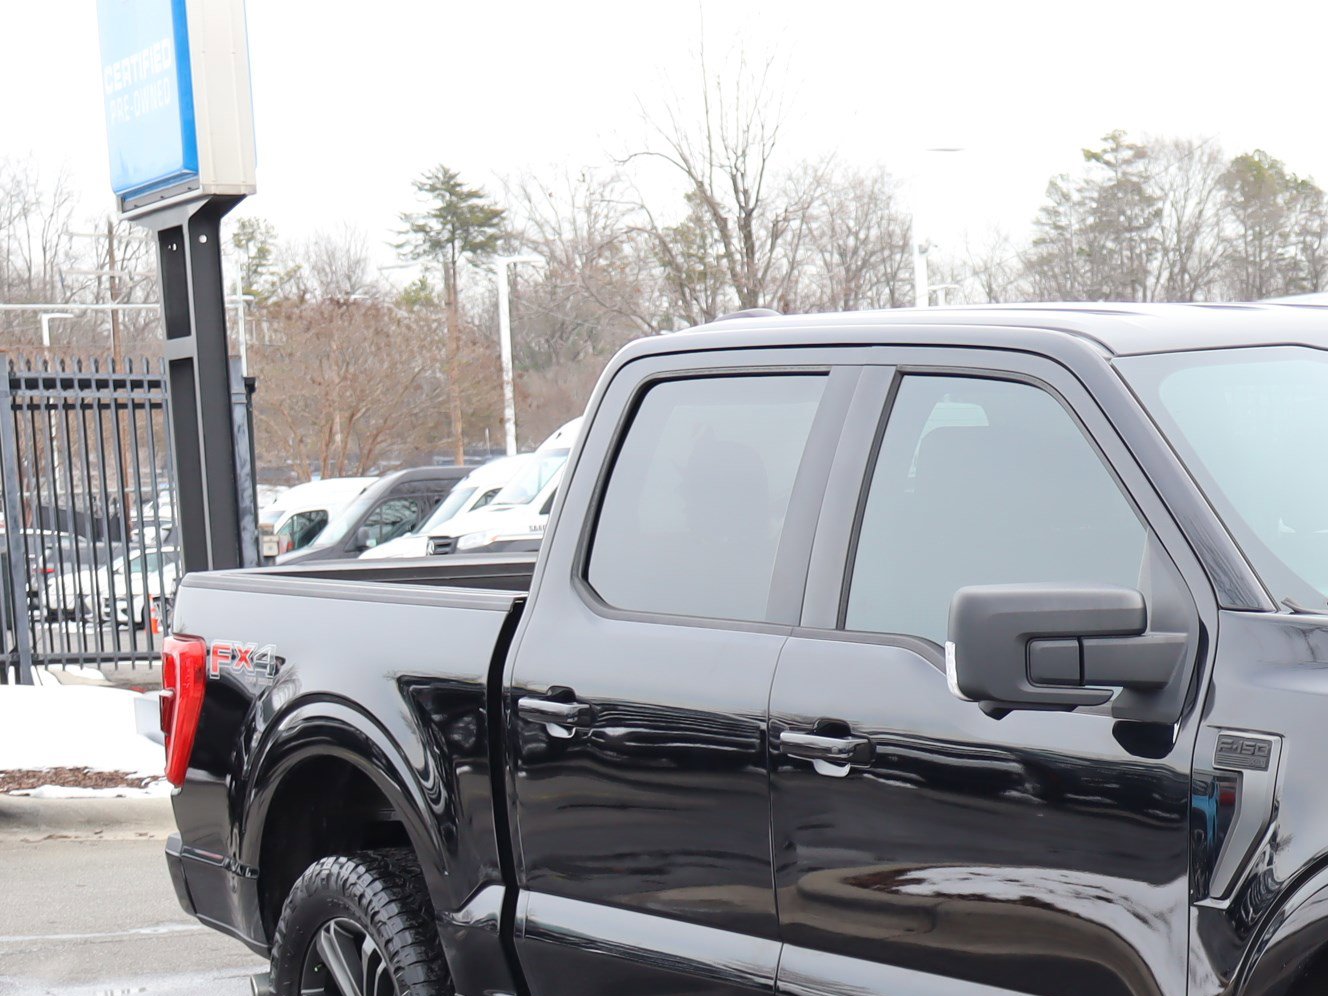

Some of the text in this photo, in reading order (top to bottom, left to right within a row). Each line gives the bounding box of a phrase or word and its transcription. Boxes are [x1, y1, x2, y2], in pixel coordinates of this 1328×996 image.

[105, 37, 171, 95] CERTIFIED
[109, 78, 171, 123] PRE-OWNED
[210, 639, 277, 679] FX4
[1219, 738, 1269, 756] F-150
